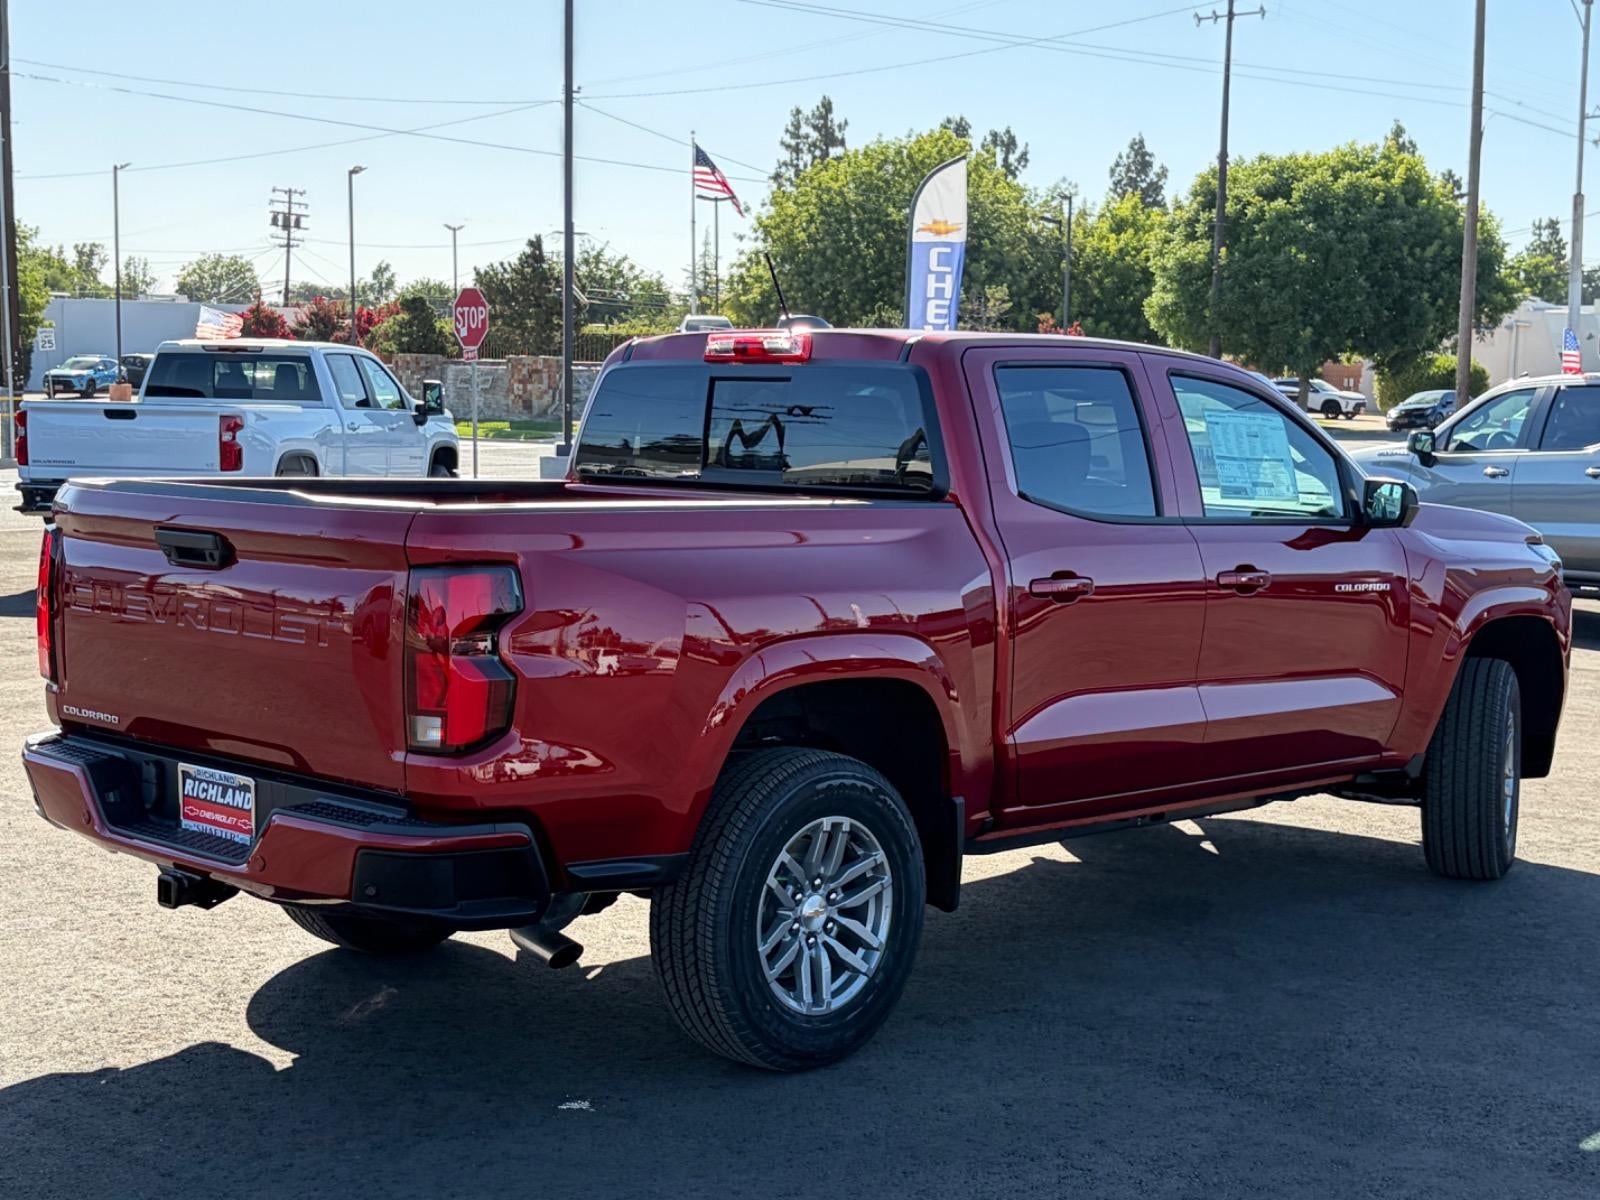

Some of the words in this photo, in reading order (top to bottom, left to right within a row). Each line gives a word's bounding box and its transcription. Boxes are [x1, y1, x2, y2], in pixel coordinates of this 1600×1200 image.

[925, 247, 952, 331] CHE
[456, 306, 486, 329] STOP
[41, 340, 54, 349] 25
[1335, 583, 1391, 592] COLORADO
[66, 581, 344, 647] CHEVROLET
[63, 705, 119, 724] COLORADO
[196, 768, 236, 785] RICHLAND
[184, 778, 252, 810] RICHLAND
[199, 809, 237, 825] CHEVROLET
